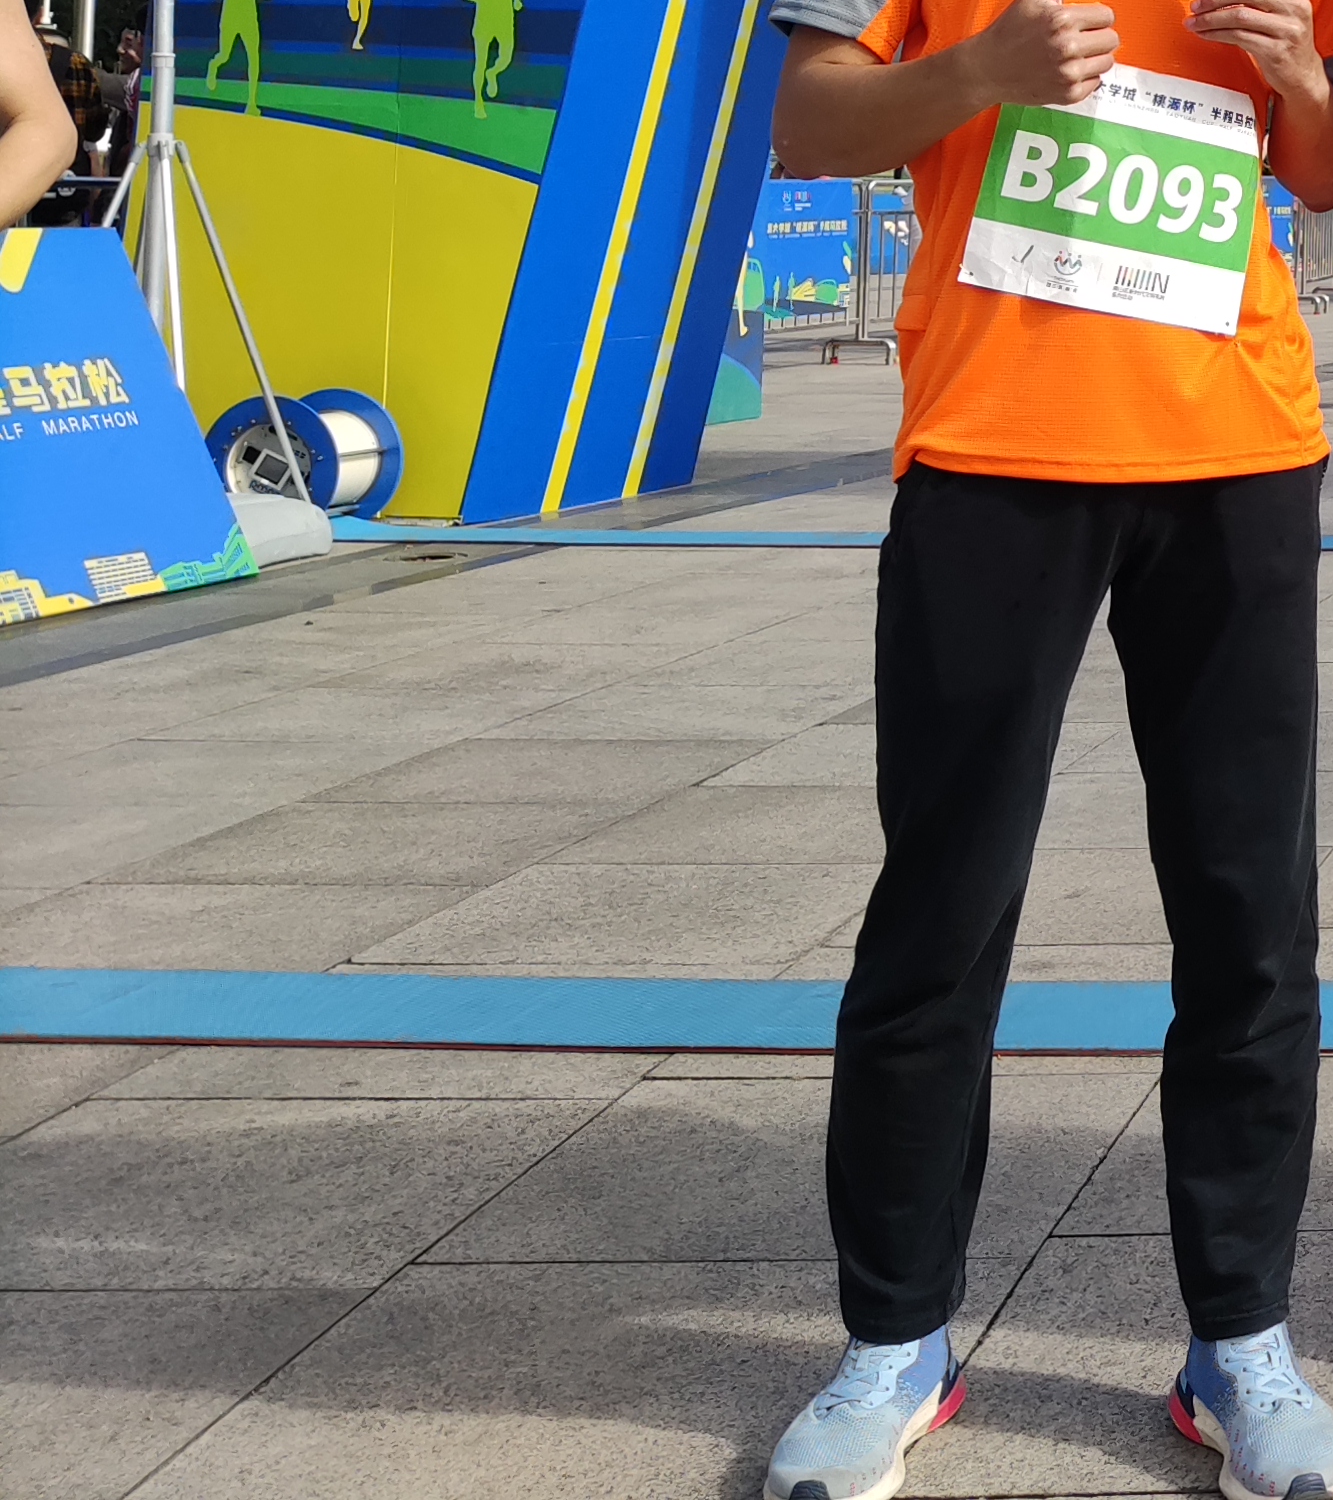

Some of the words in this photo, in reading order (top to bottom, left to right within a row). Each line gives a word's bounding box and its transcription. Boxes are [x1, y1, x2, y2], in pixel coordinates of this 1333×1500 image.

[1209, 106, 1258, 132] 半程马拉
[1000, 129, 1244, 244] B2093
[42, 409, 139, 436] MARATHON
